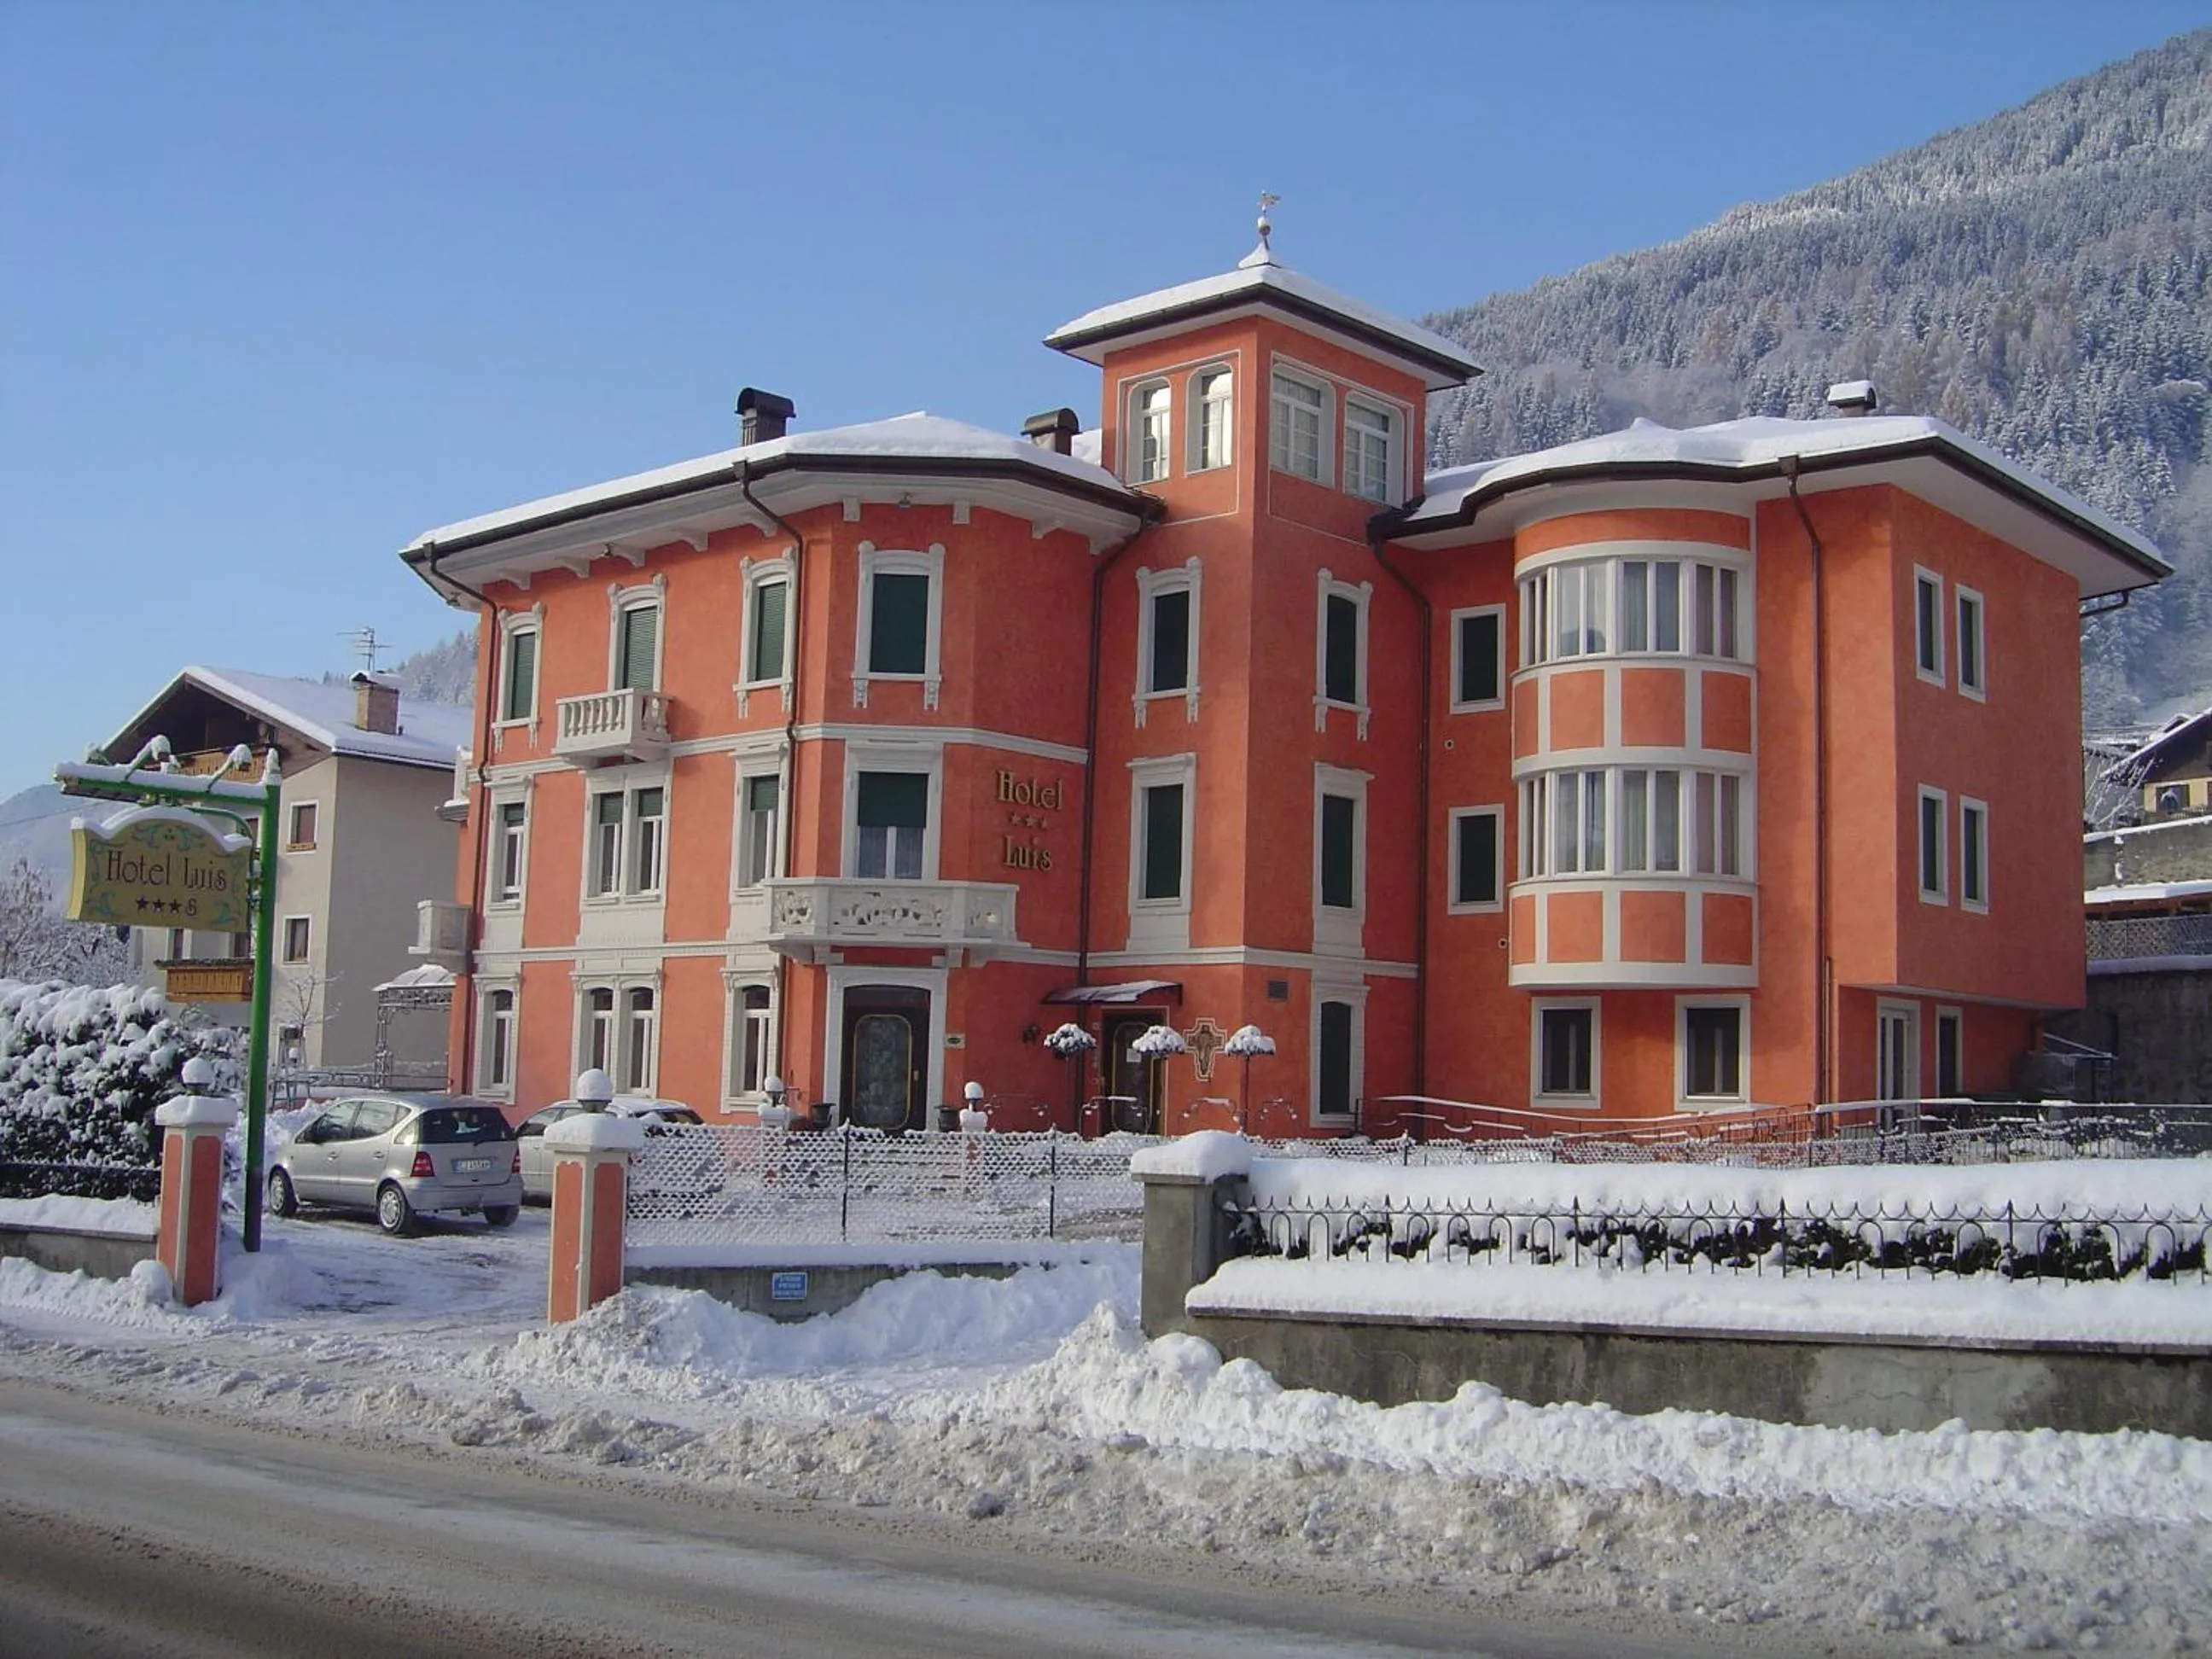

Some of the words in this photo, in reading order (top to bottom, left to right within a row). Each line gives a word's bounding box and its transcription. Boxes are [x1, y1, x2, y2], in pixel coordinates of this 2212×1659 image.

[998, 770, 1063, 810] Hotel
[106, 850, 171, 886] Hotel
[183, 857, 226, 891] Luis
[1004, 835, 1052, 871] Luis
